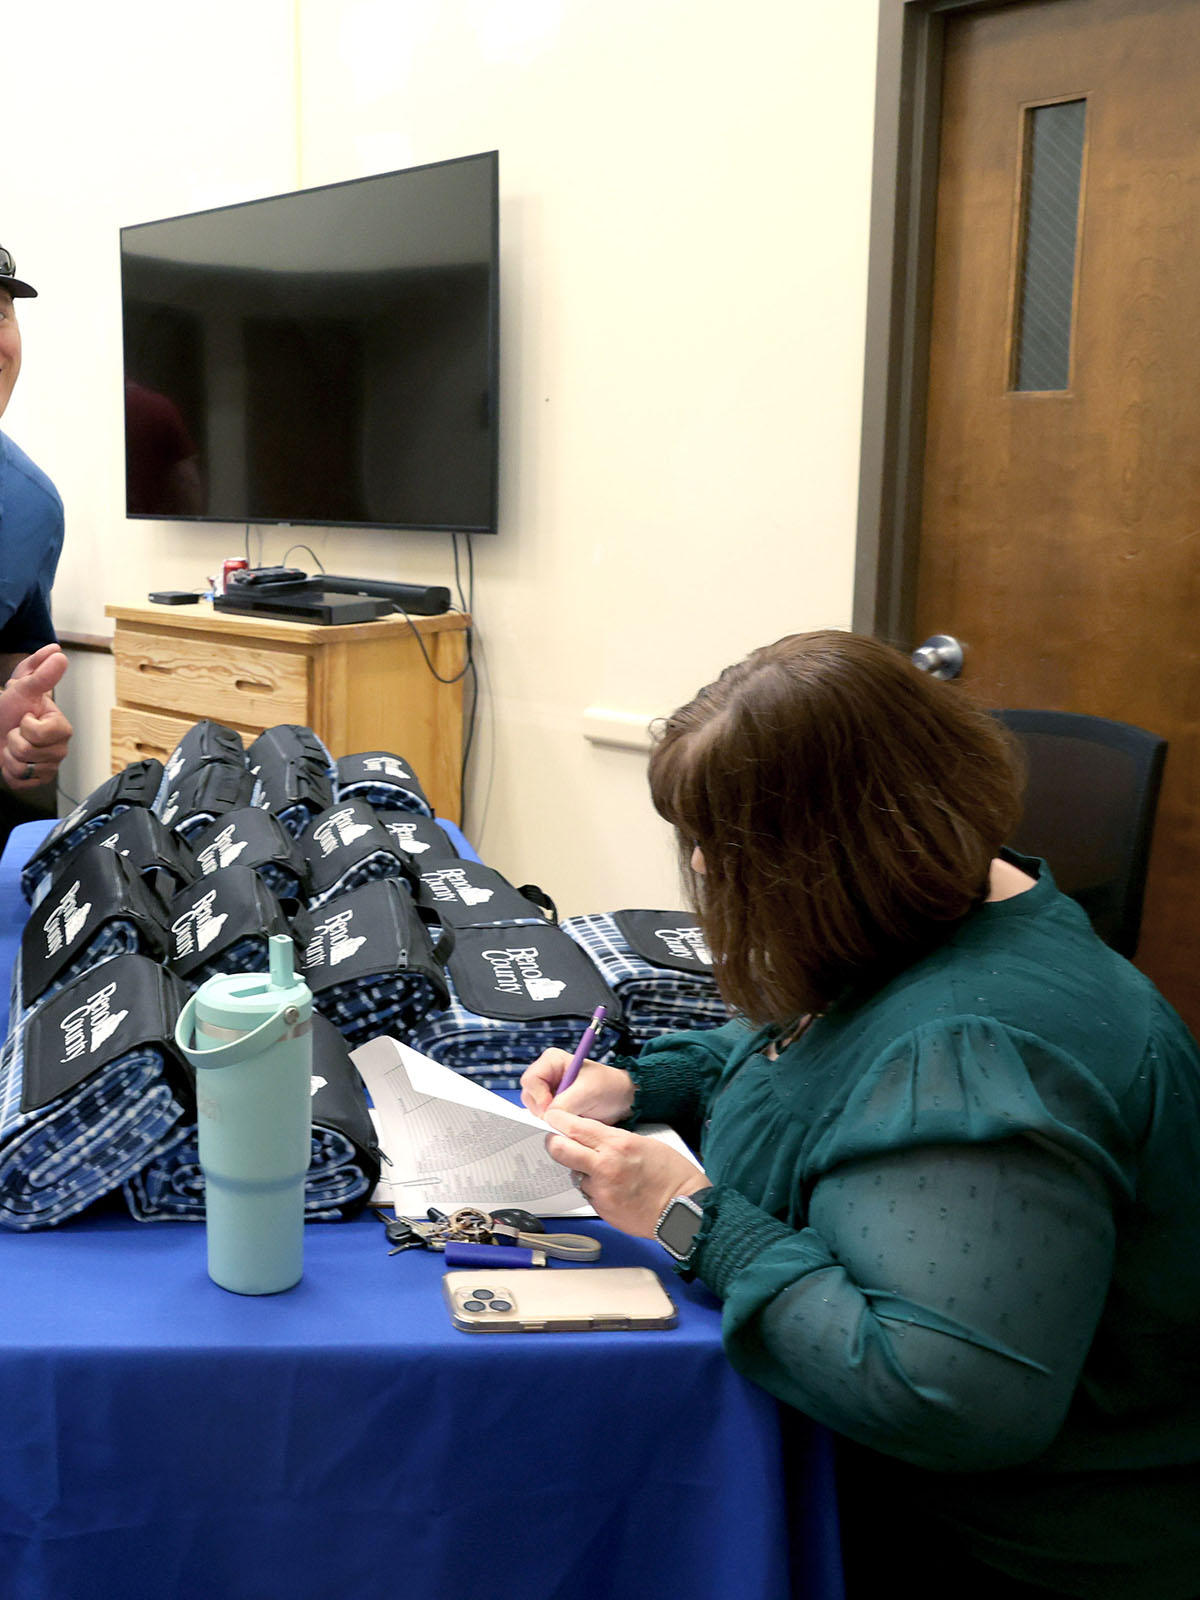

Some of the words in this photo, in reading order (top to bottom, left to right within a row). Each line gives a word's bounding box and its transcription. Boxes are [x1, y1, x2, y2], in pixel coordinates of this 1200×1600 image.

[420, 872, 458, 902] County
[435, 868, 472, 889] Reno
[191, 889, 217, 928] Reno
[325, 909, 353, 946] Reno
[171, 910, 195, 960] County
[654, 929, 694, 960] County
[481, 949, 523, 995] County
[505, 947, 543, 979] Reno
[86, 982, 117, 1026] Reno
[60, 1005, 88, 1063] County
